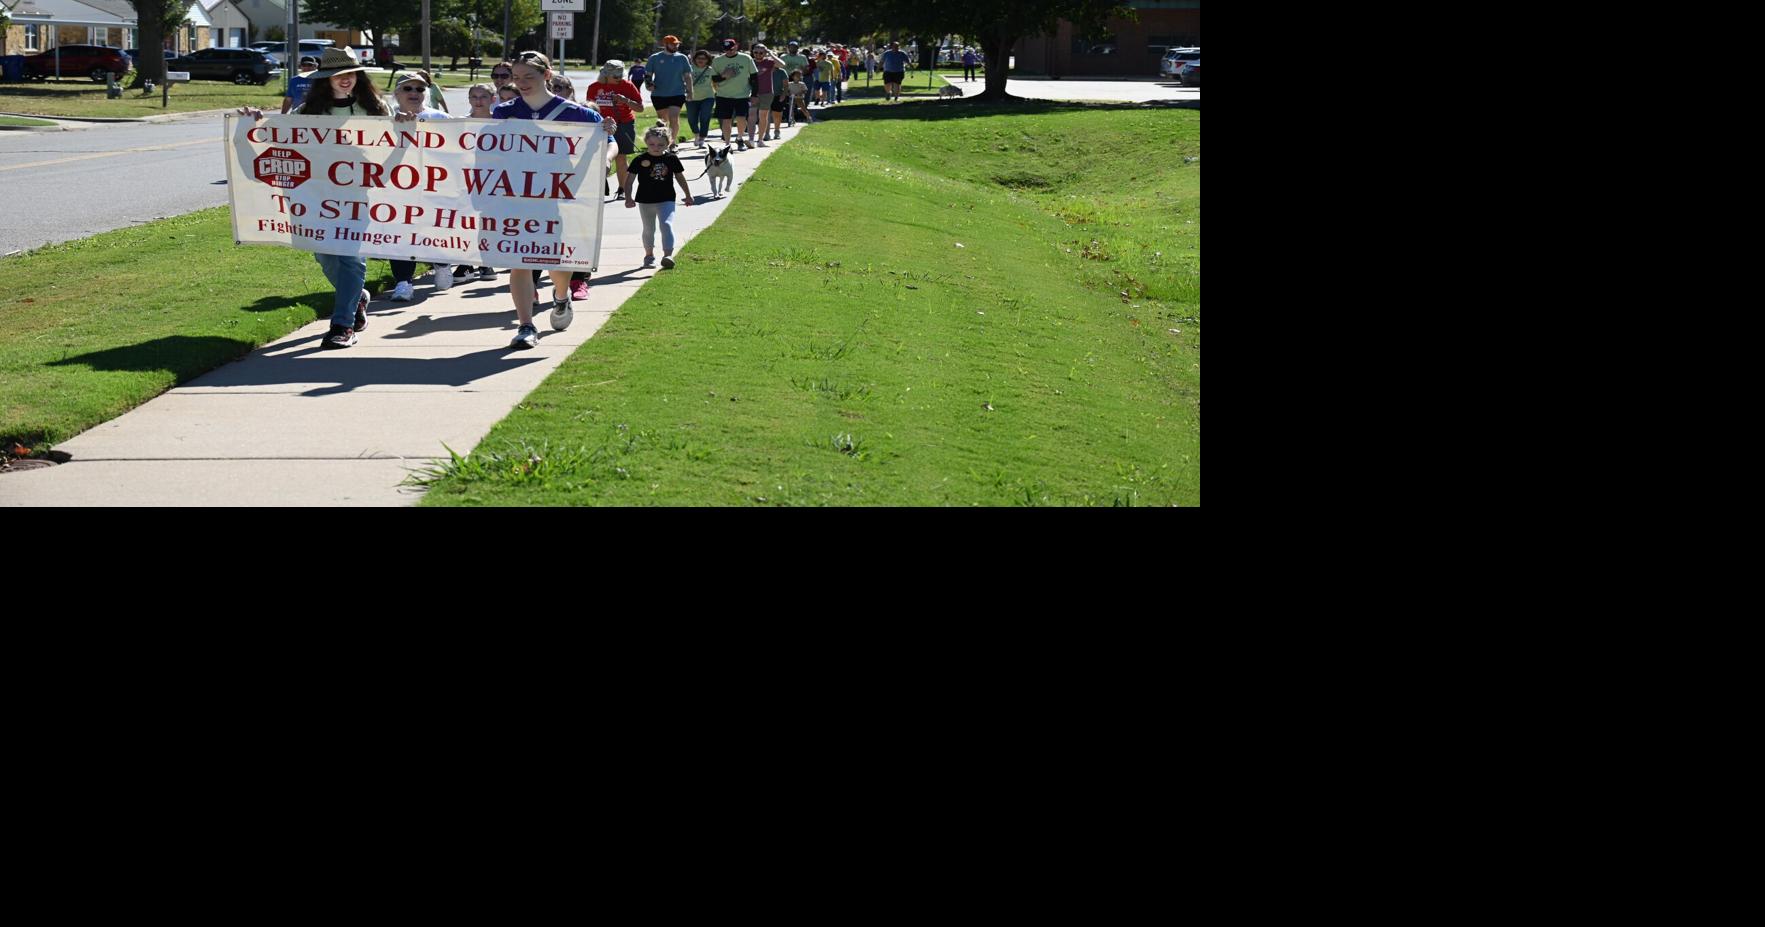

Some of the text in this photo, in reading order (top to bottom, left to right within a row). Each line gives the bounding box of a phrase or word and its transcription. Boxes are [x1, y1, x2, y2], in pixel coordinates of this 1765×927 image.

[247, 127, 584, 156] CLEVELAND COUNTY
[259, 158, 306, 175] CROP
[327, 160, 577, 200] CROP WALK
[271, 194, 560, 237] To STOP Hunger
[256, 219, 577, 258] Fighting Hunger Locally & Globally
